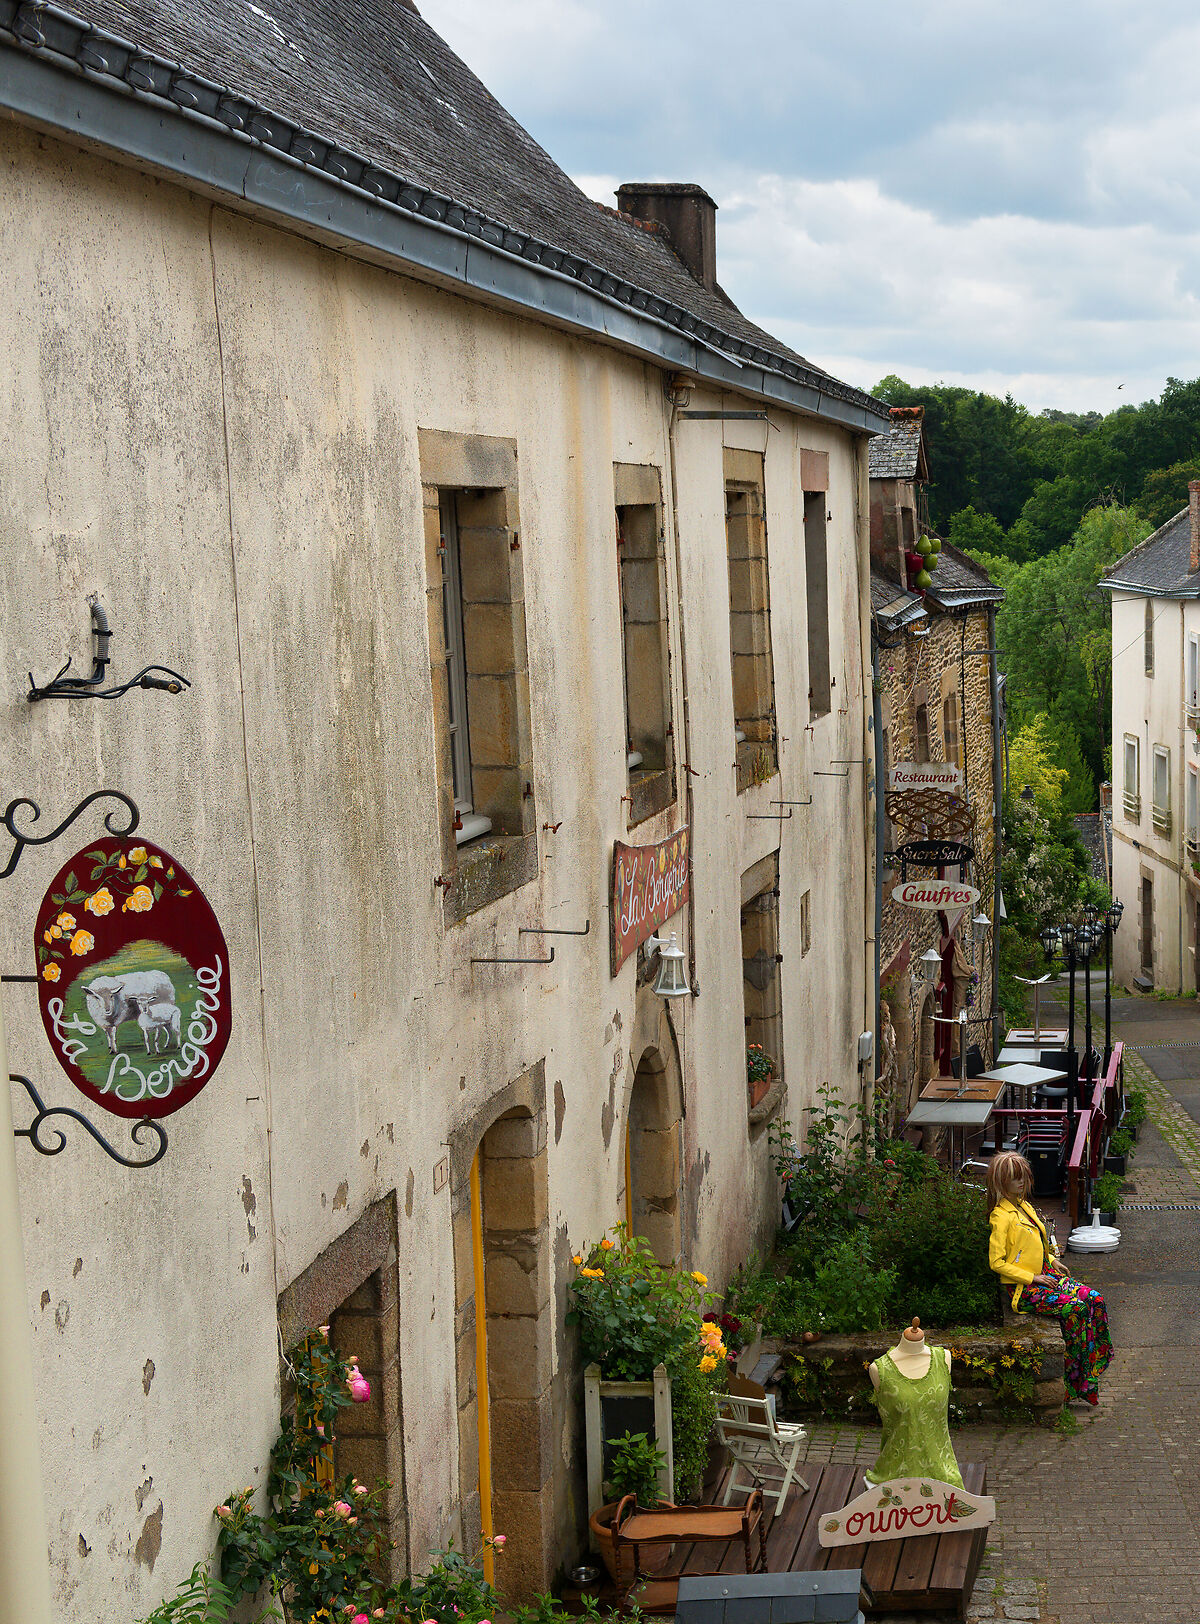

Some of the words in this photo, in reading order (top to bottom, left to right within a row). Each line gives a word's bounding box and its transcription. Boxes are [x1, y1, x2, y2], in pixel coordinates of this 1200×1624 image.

[894, 771, 958, 783] Restaurant
[621, 857, 640, 936] La
[641, 857, 687, 920] Bergerie
[902, 885, 971, 905] Gaufres
[48, 997, 97, 1066] La
[100, 953, 223, 1102] Bergerie
[846, 1493, 959, 1537] ouvert
